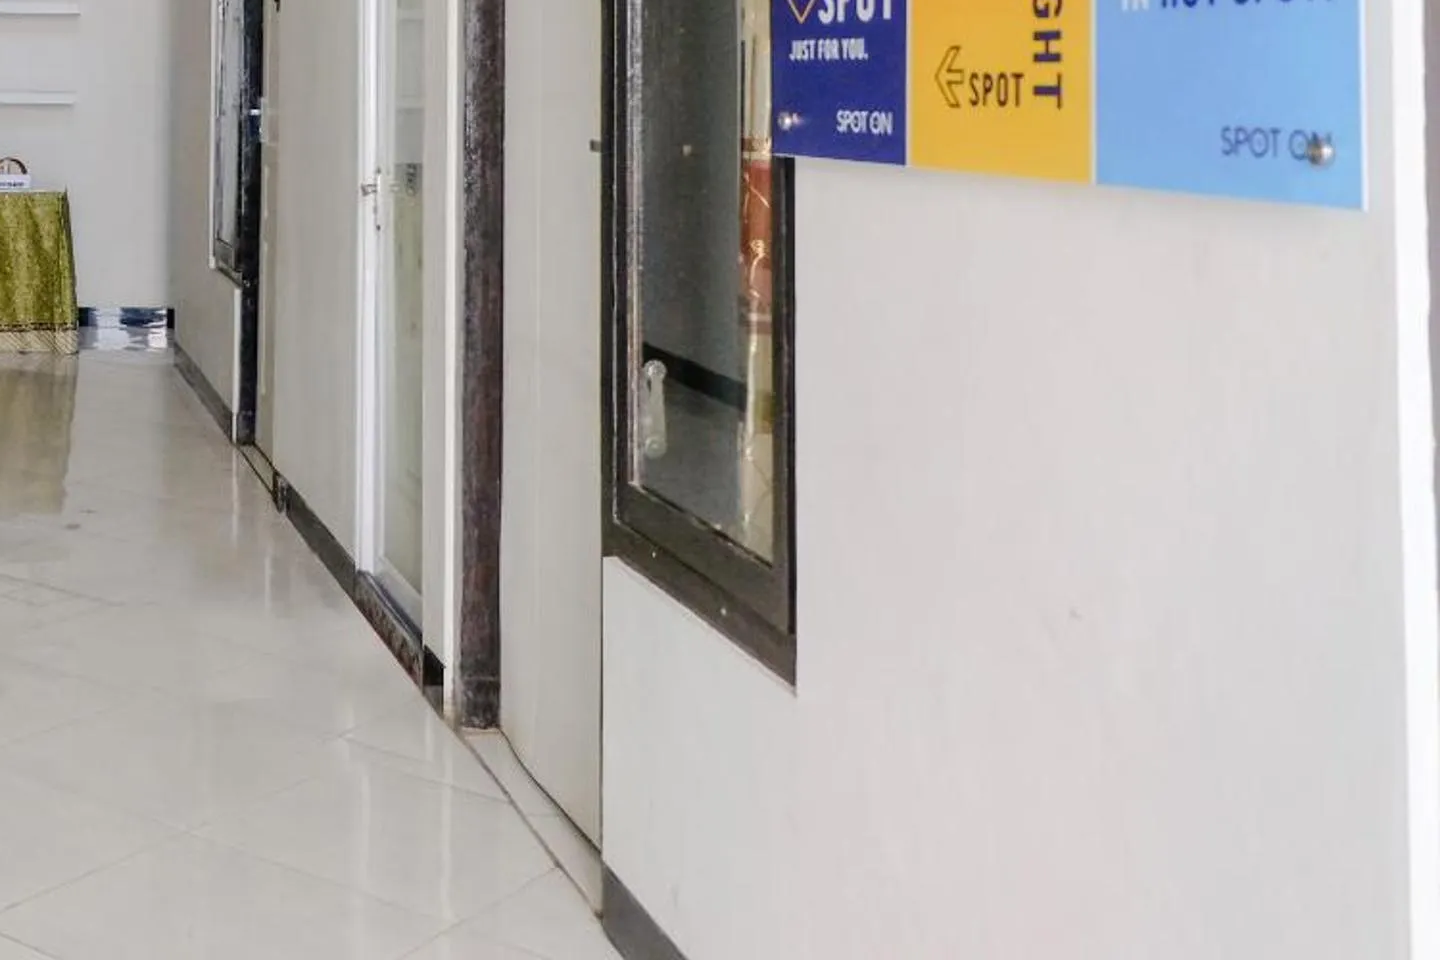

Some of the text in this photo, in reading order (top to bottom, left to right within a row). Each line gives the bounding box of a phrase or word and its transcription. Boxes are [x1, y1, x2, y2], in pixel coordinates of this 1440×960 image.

[788, 38, 869, 62] JUST FOR YOU.
[968, 71, 1025, 108] SPOT
[835, 110, 893, 136] SPOT ON
[1220, 125, 1281, 158] SPOT
